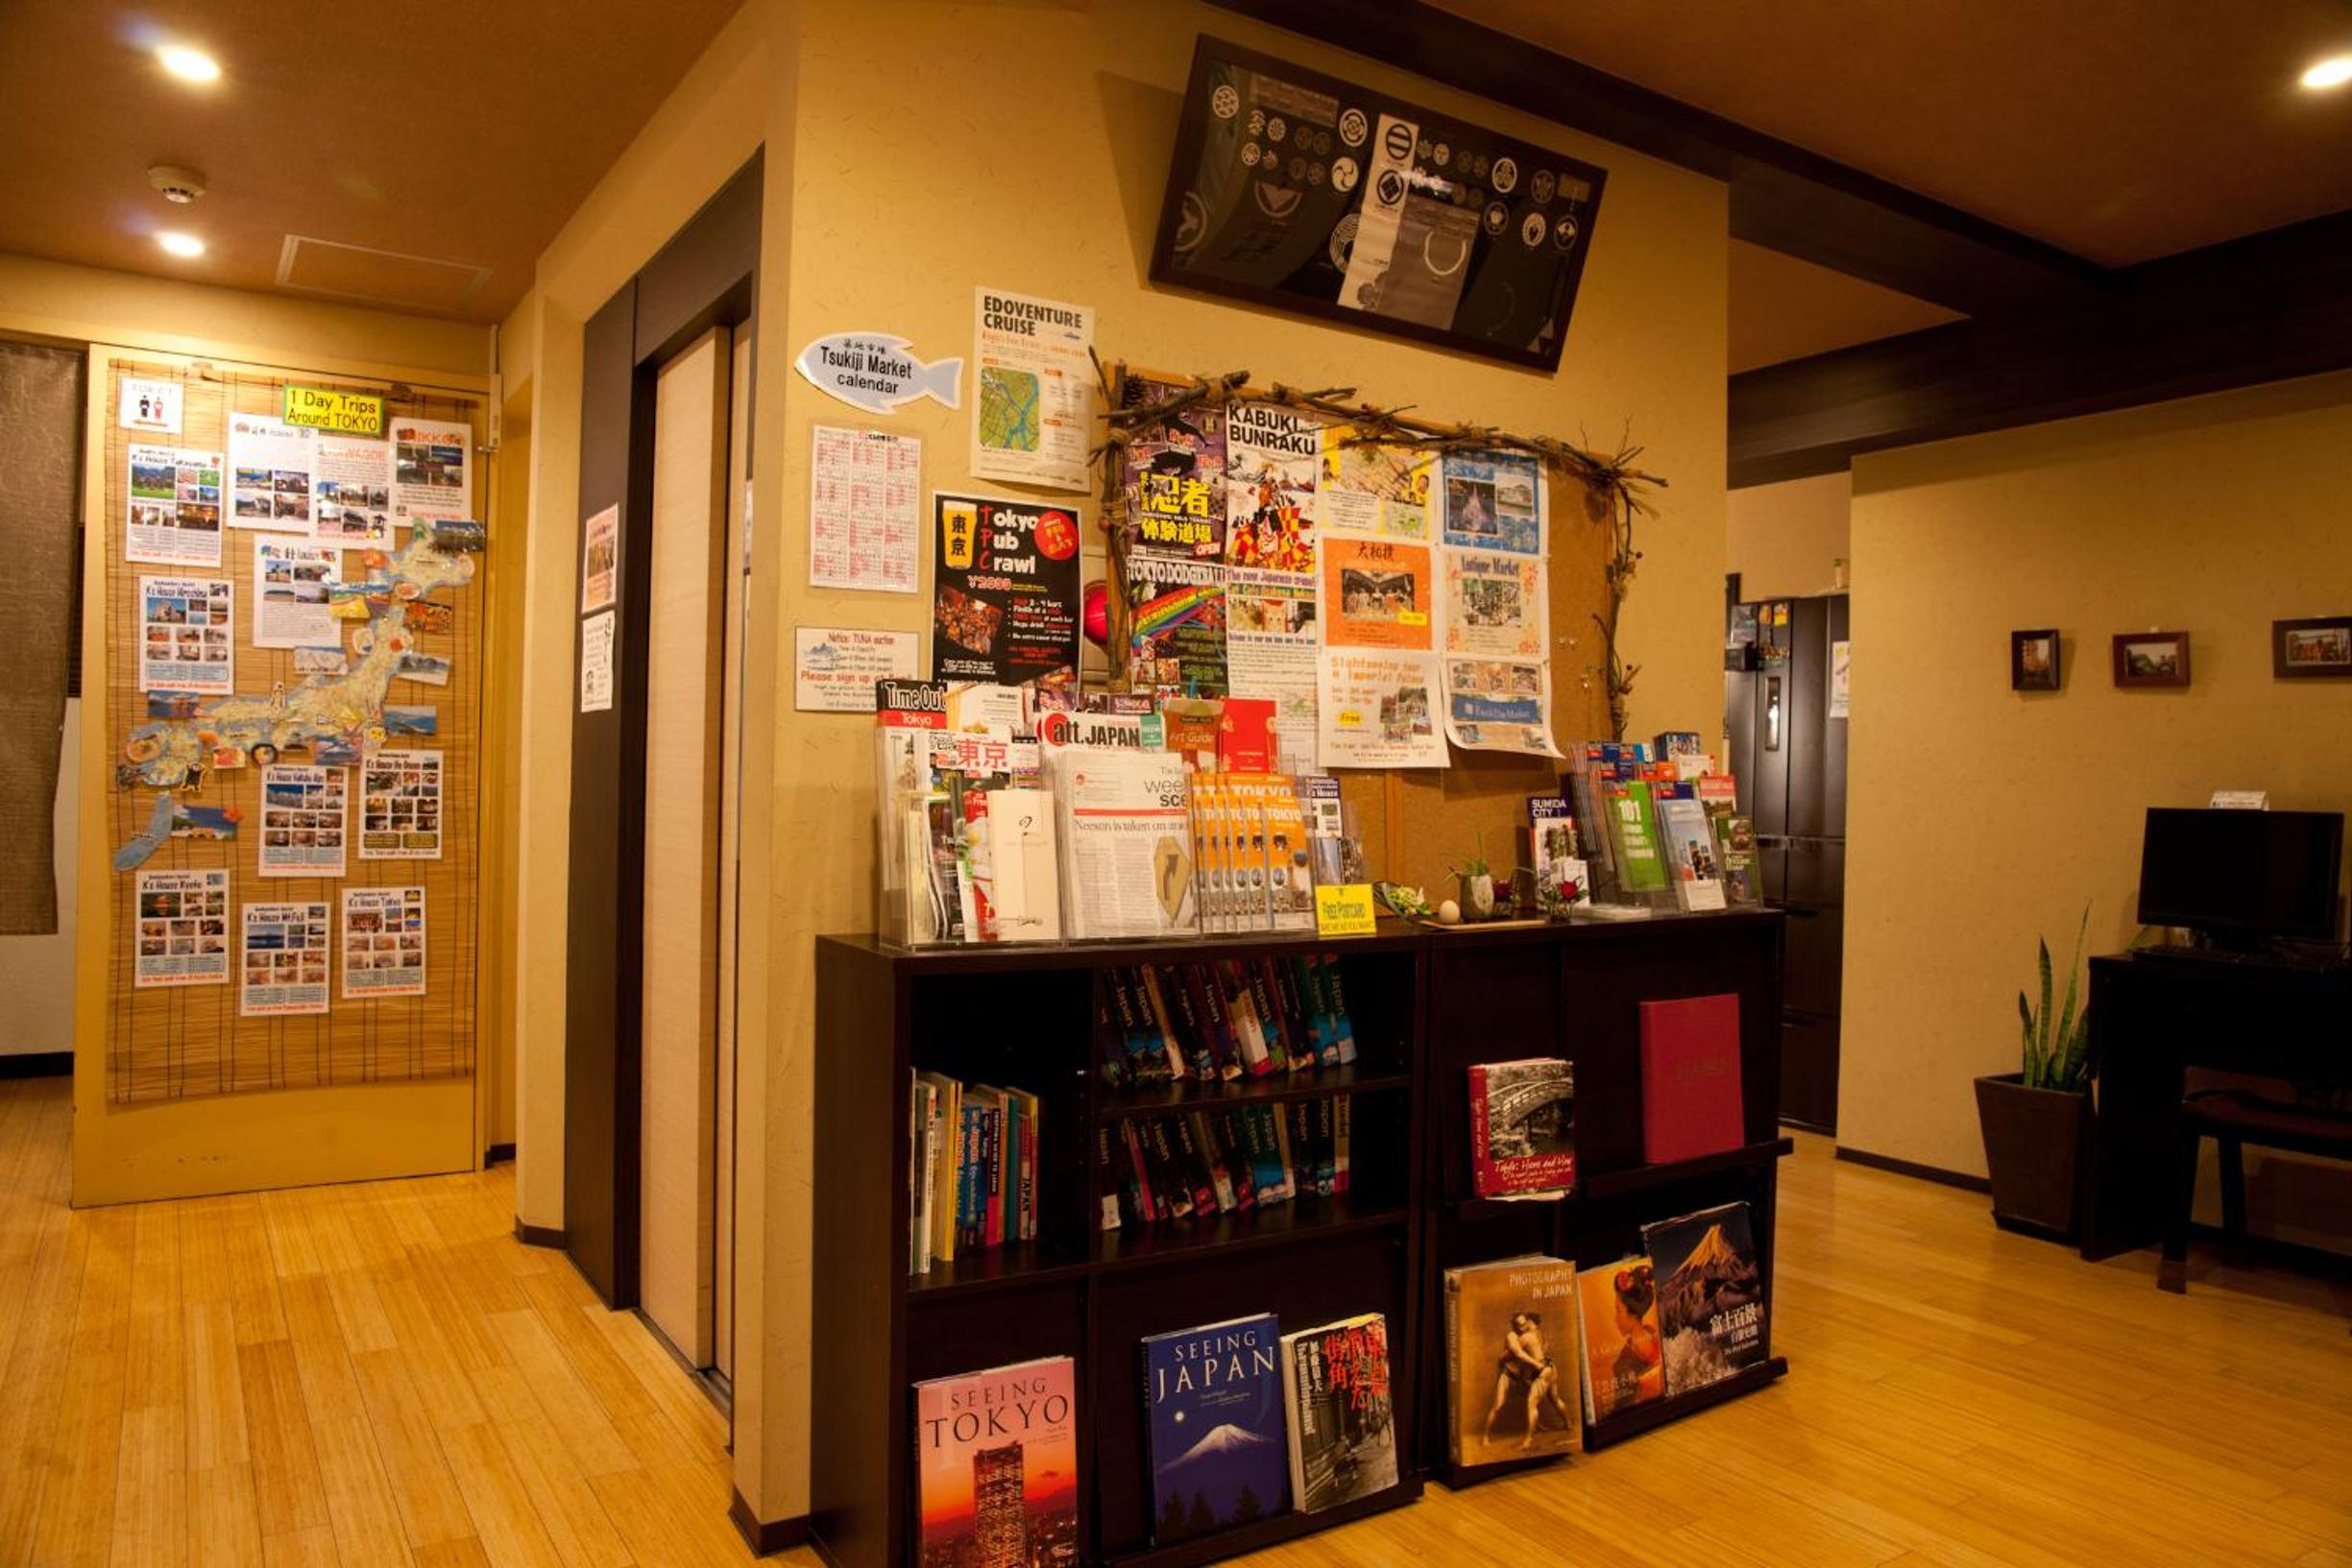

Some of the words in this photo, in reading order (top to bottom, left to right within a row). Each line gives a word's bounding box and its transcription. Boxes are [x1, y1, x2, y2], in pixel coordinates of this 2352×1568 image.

[984, 296, 1082, 328] EDOVENTURE
[984, 313, 1036, 336] CRUISE
[821, 346, 863, 372] Tsukiji
[867, 354, 912, 379] Market
[837, 373, 899, 395] calendar
[291, 390, 296, 404] 1
[304, 391, 333, 410] Day
[340, 396, 376, 415] Trips
[288, 407, 330, 426] Around
[335, 413, 378, 432] TOKYO
[1228, 404, 1299, 432] KABUKI
[1229, 424, 1316, 455] BUNRAKU
[1151, 473, 1211, 518] 忍者
[980, 504, 1039, 532] Tokyo
[952, 515, 966, 557] 東京
[980, 528, 1019, 550] Pub
[980, 550, 1035, 574] Crawl
[1461, 554, 1491, 578] Antique
[1492, 556, 1519, 577] Market
[801, 670, 832, 683] Please
[837, 673, 856, 685] sign
[902, 712, 934, 728] Tokyo
[957, 738, 1009, 769] 東京
[1531, 798, 1567, 808] SUMIDA
[1532, 808, 1554, 818] CITY
[1618, 799, 1641, 823] 101
[1206, 984, 1221, 1024] Japan
[1509, 1268, 1572, 1288] PHOTOGRAPHY
[1532, 1286, 1542, 1299] IN
[1543, 1283, 1572, 1298] JAPAN
[1175, 1330, 1256, 1363] SEEING
[1156, 1346, 1275, 1404] JAPAN
[951, 1378, 1047, 1411] SEEING
[926, 1394, 1069, 1448] TOKYO
